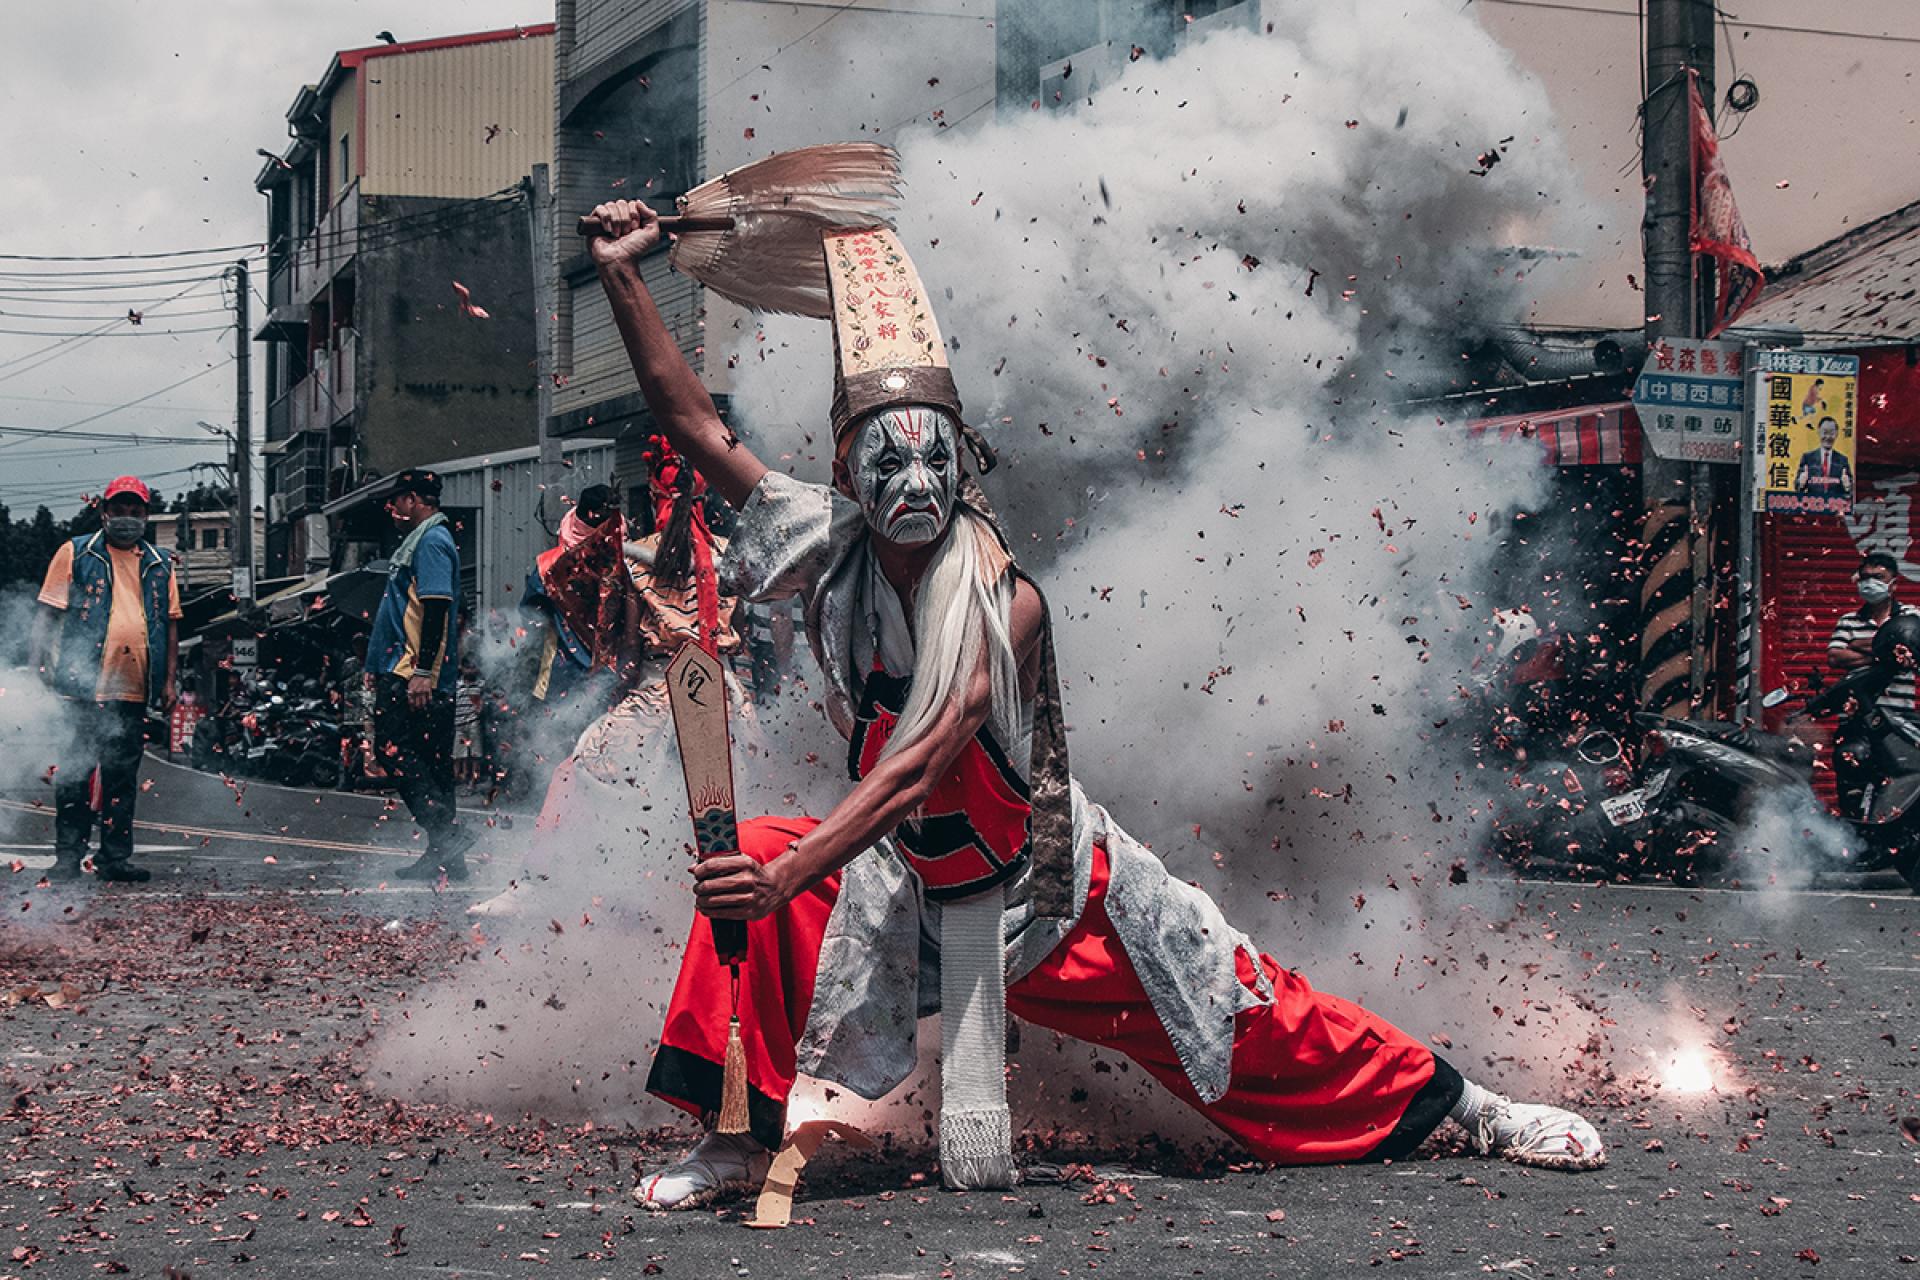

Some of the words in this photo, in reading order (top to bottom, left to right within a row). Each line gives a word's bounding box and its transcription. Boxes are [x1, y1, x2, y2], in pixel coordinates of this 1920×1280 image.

[1768, 376, 1792, 488] 國華徵信
[234, 646, 255, 658] 146
